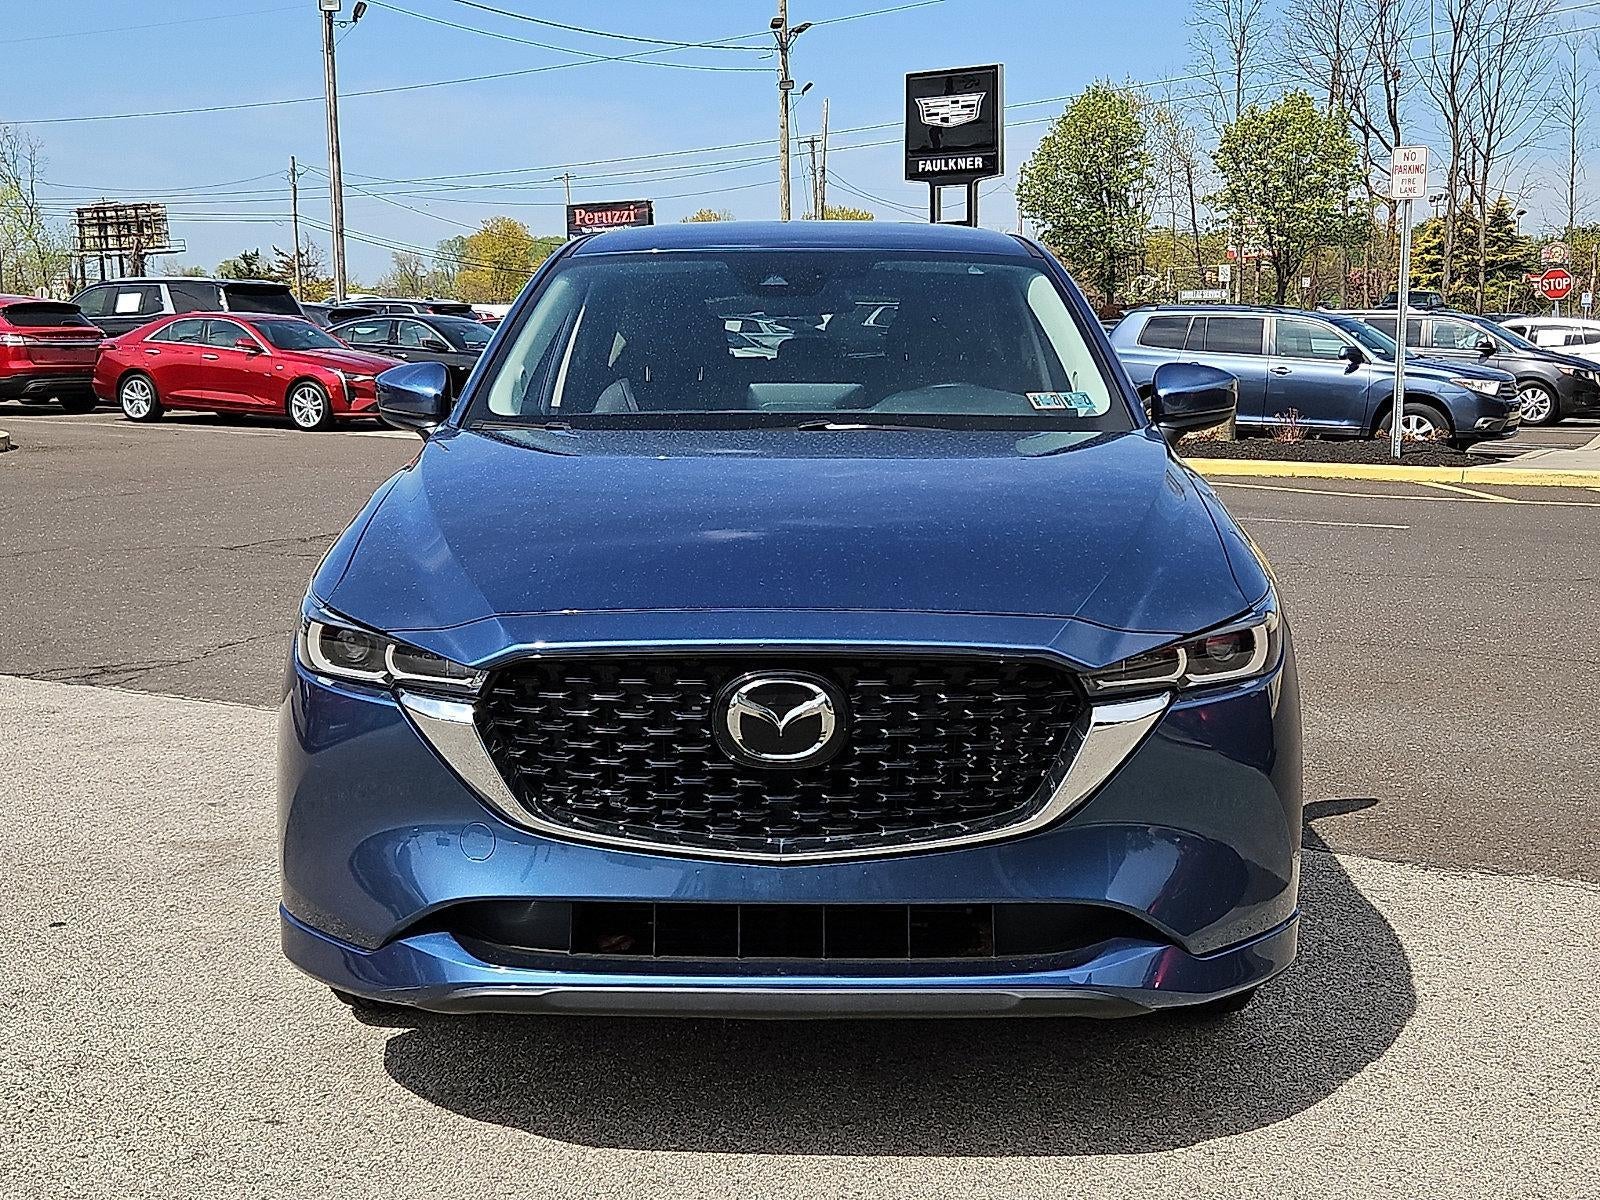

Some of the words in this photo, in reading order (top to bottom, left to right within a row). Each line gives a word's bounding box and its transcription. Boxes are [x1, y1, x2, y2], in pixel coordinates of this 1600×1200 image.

[1403, 151, 1417, 161] NO
[918, 157, 983, 173] FAULKNER
[1394, 164, 1425, 175] PARKING
[573, 205, 636, 226] Peruzzi
[1542, 277, 1571, 291] STOP
